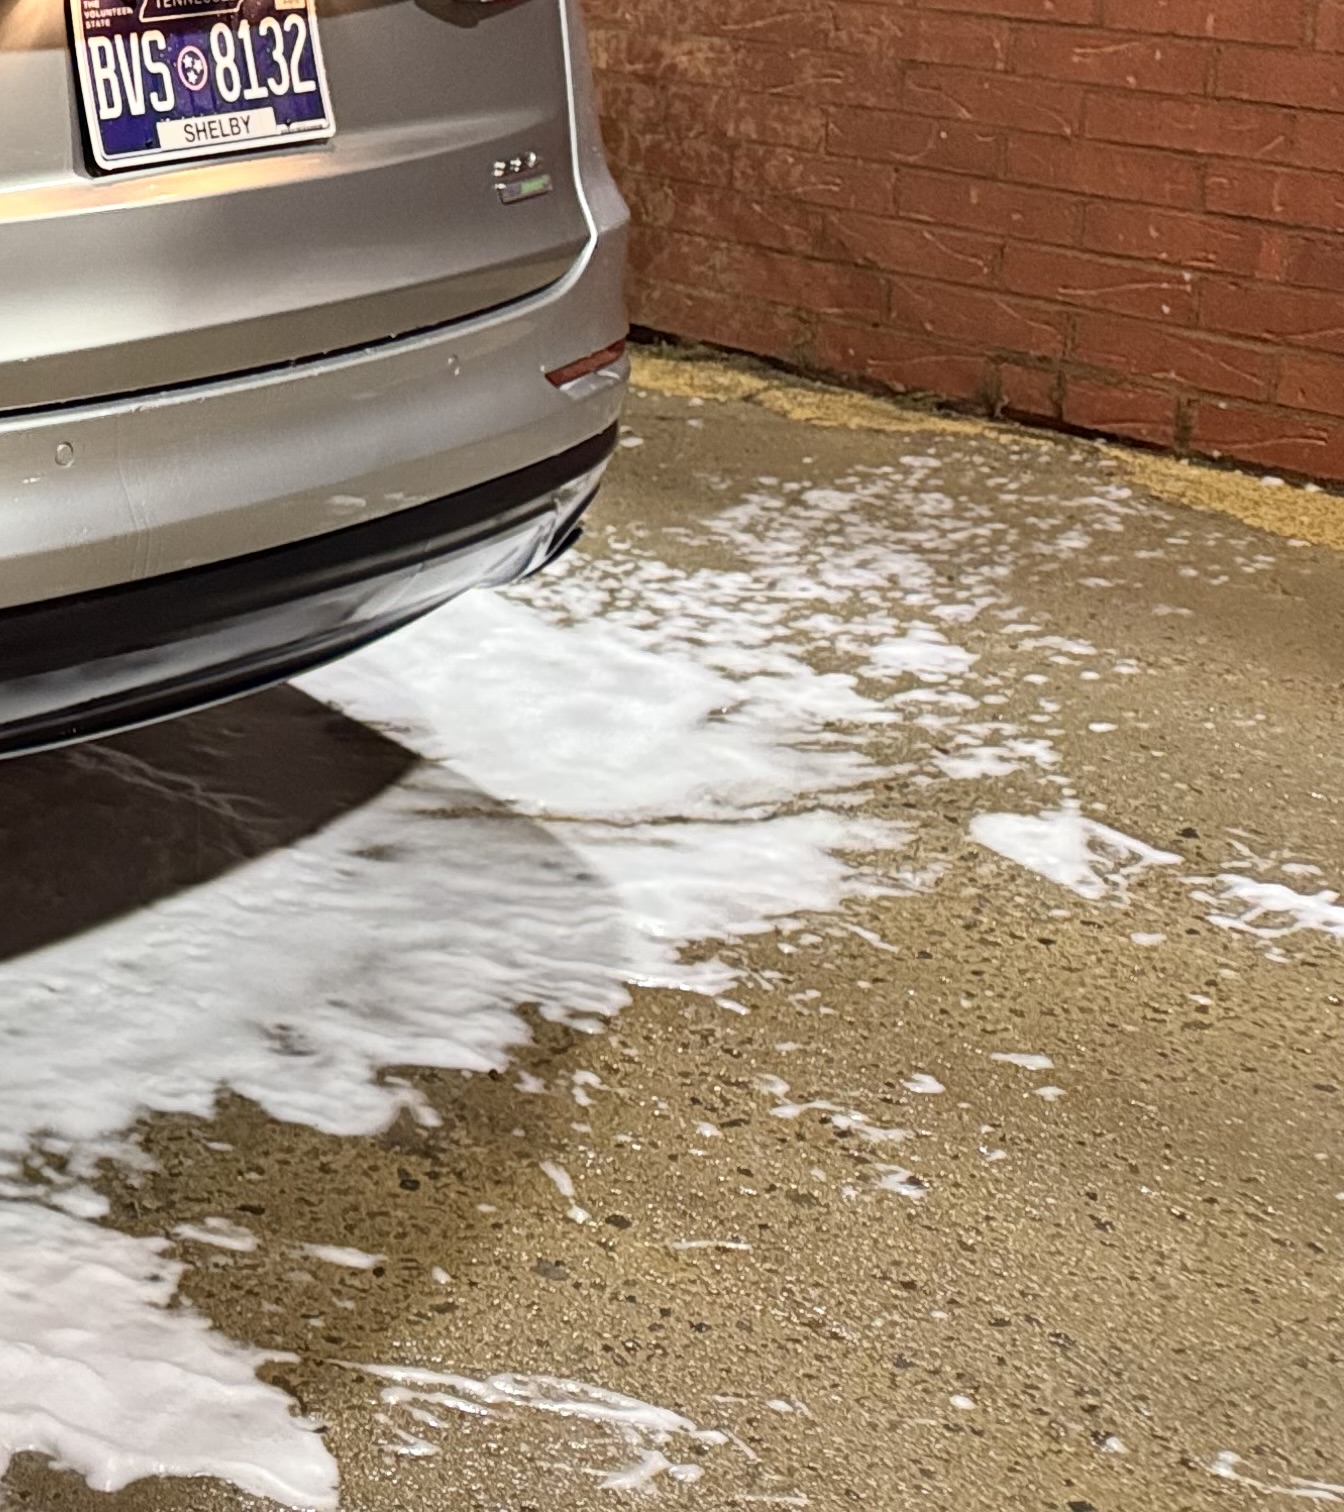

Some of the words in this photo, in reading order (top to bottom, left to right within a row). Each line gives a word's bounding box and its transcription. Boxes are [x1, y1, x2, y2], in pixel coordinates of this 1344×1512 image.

[87, 29, 176, 121] BVS
[209, 14, 317, 104] 8132
[183, 115, 251, 143] SHELBY
